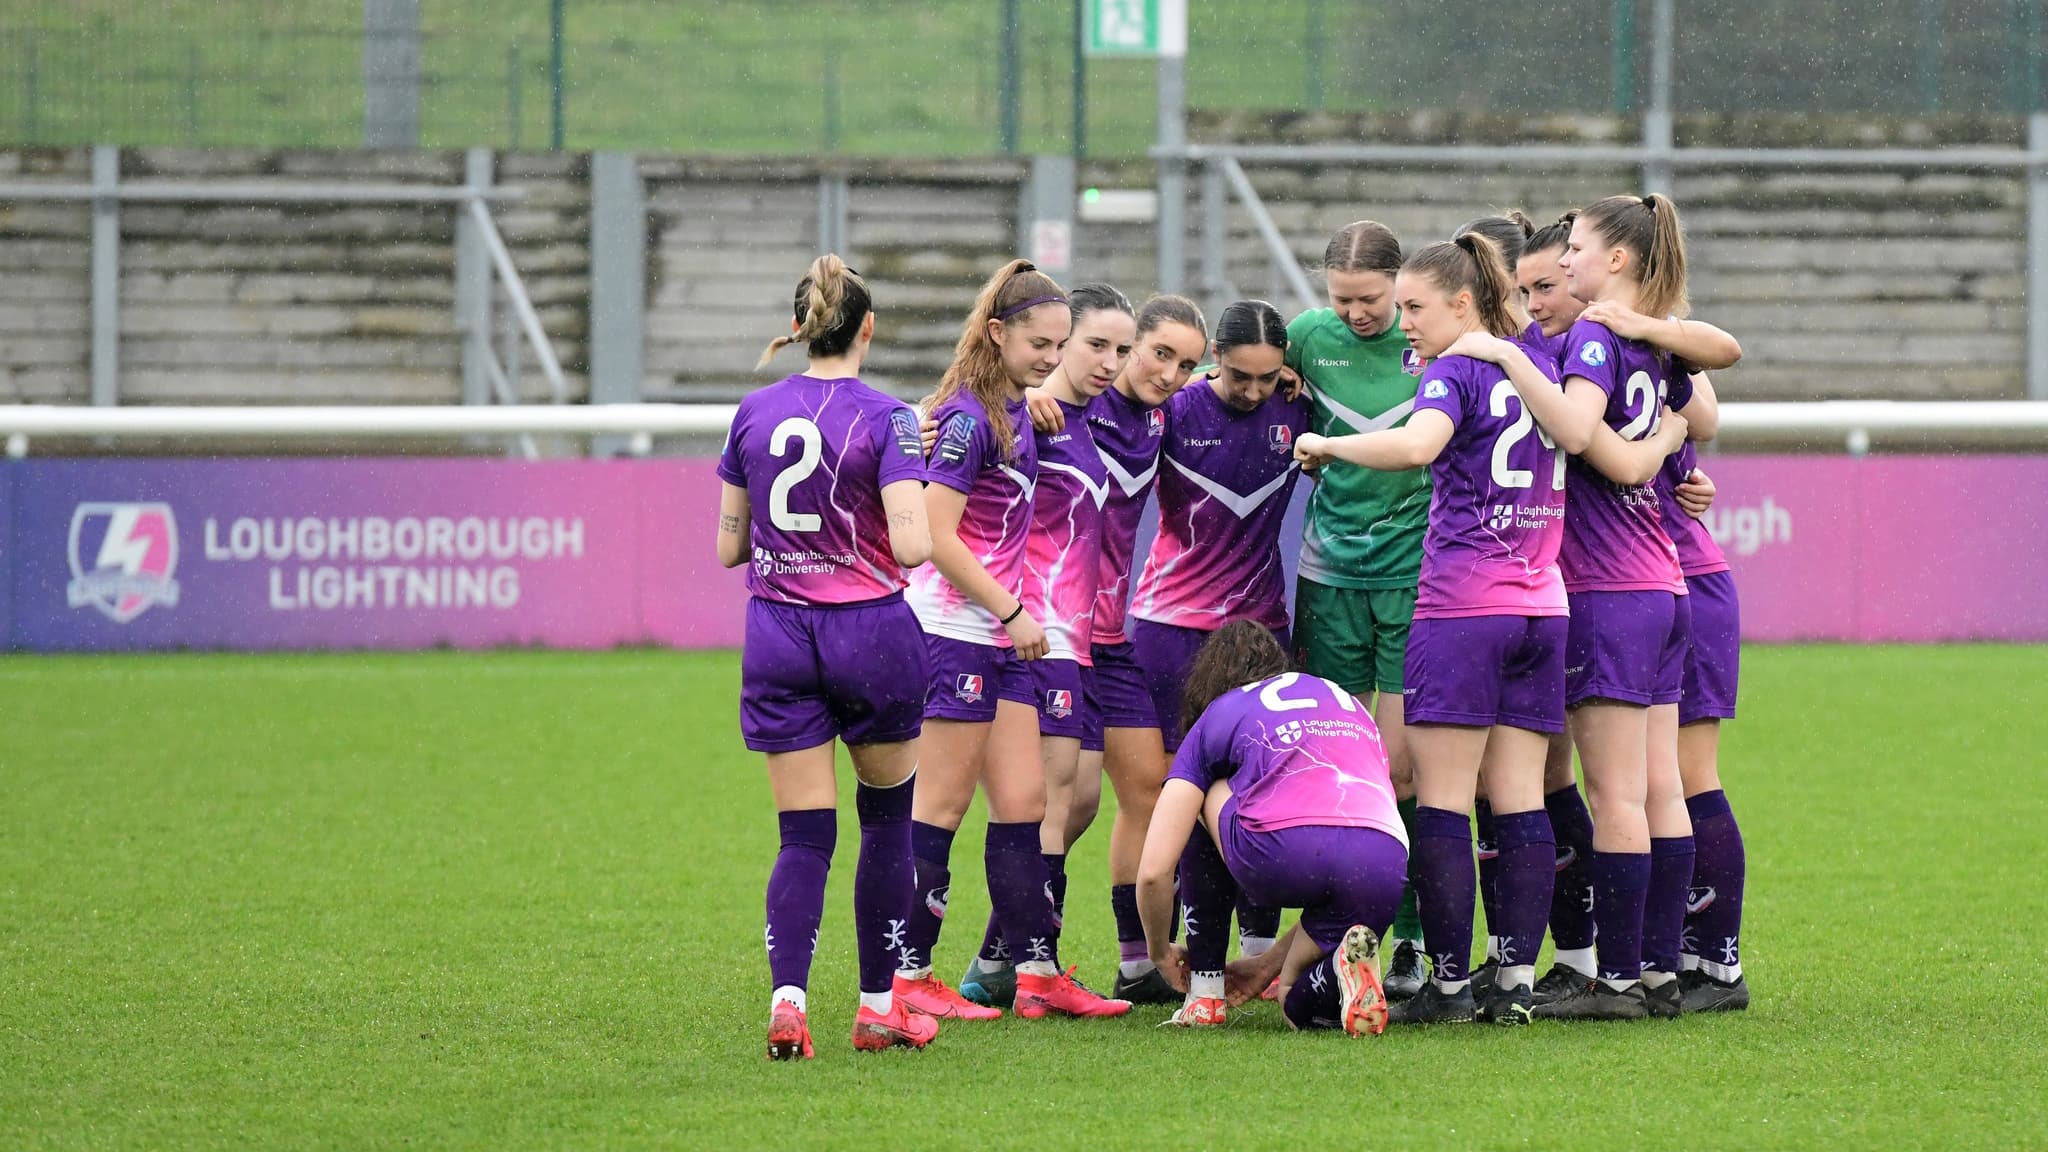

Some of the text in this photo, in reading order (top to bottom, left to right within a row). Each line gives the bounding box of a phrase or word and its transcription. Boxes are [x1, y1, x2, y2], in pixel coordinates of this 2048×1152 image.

[769, 417, 822, 532] 2
[204, 516, 585, 562] LOUGHBOROUGH
[1703, 496, 1792, 557] ugh
[268, 566, 520, 610] LIGHTNING
[775, 563, 836, 575] University
[1305, 727, 1360, 741] University
